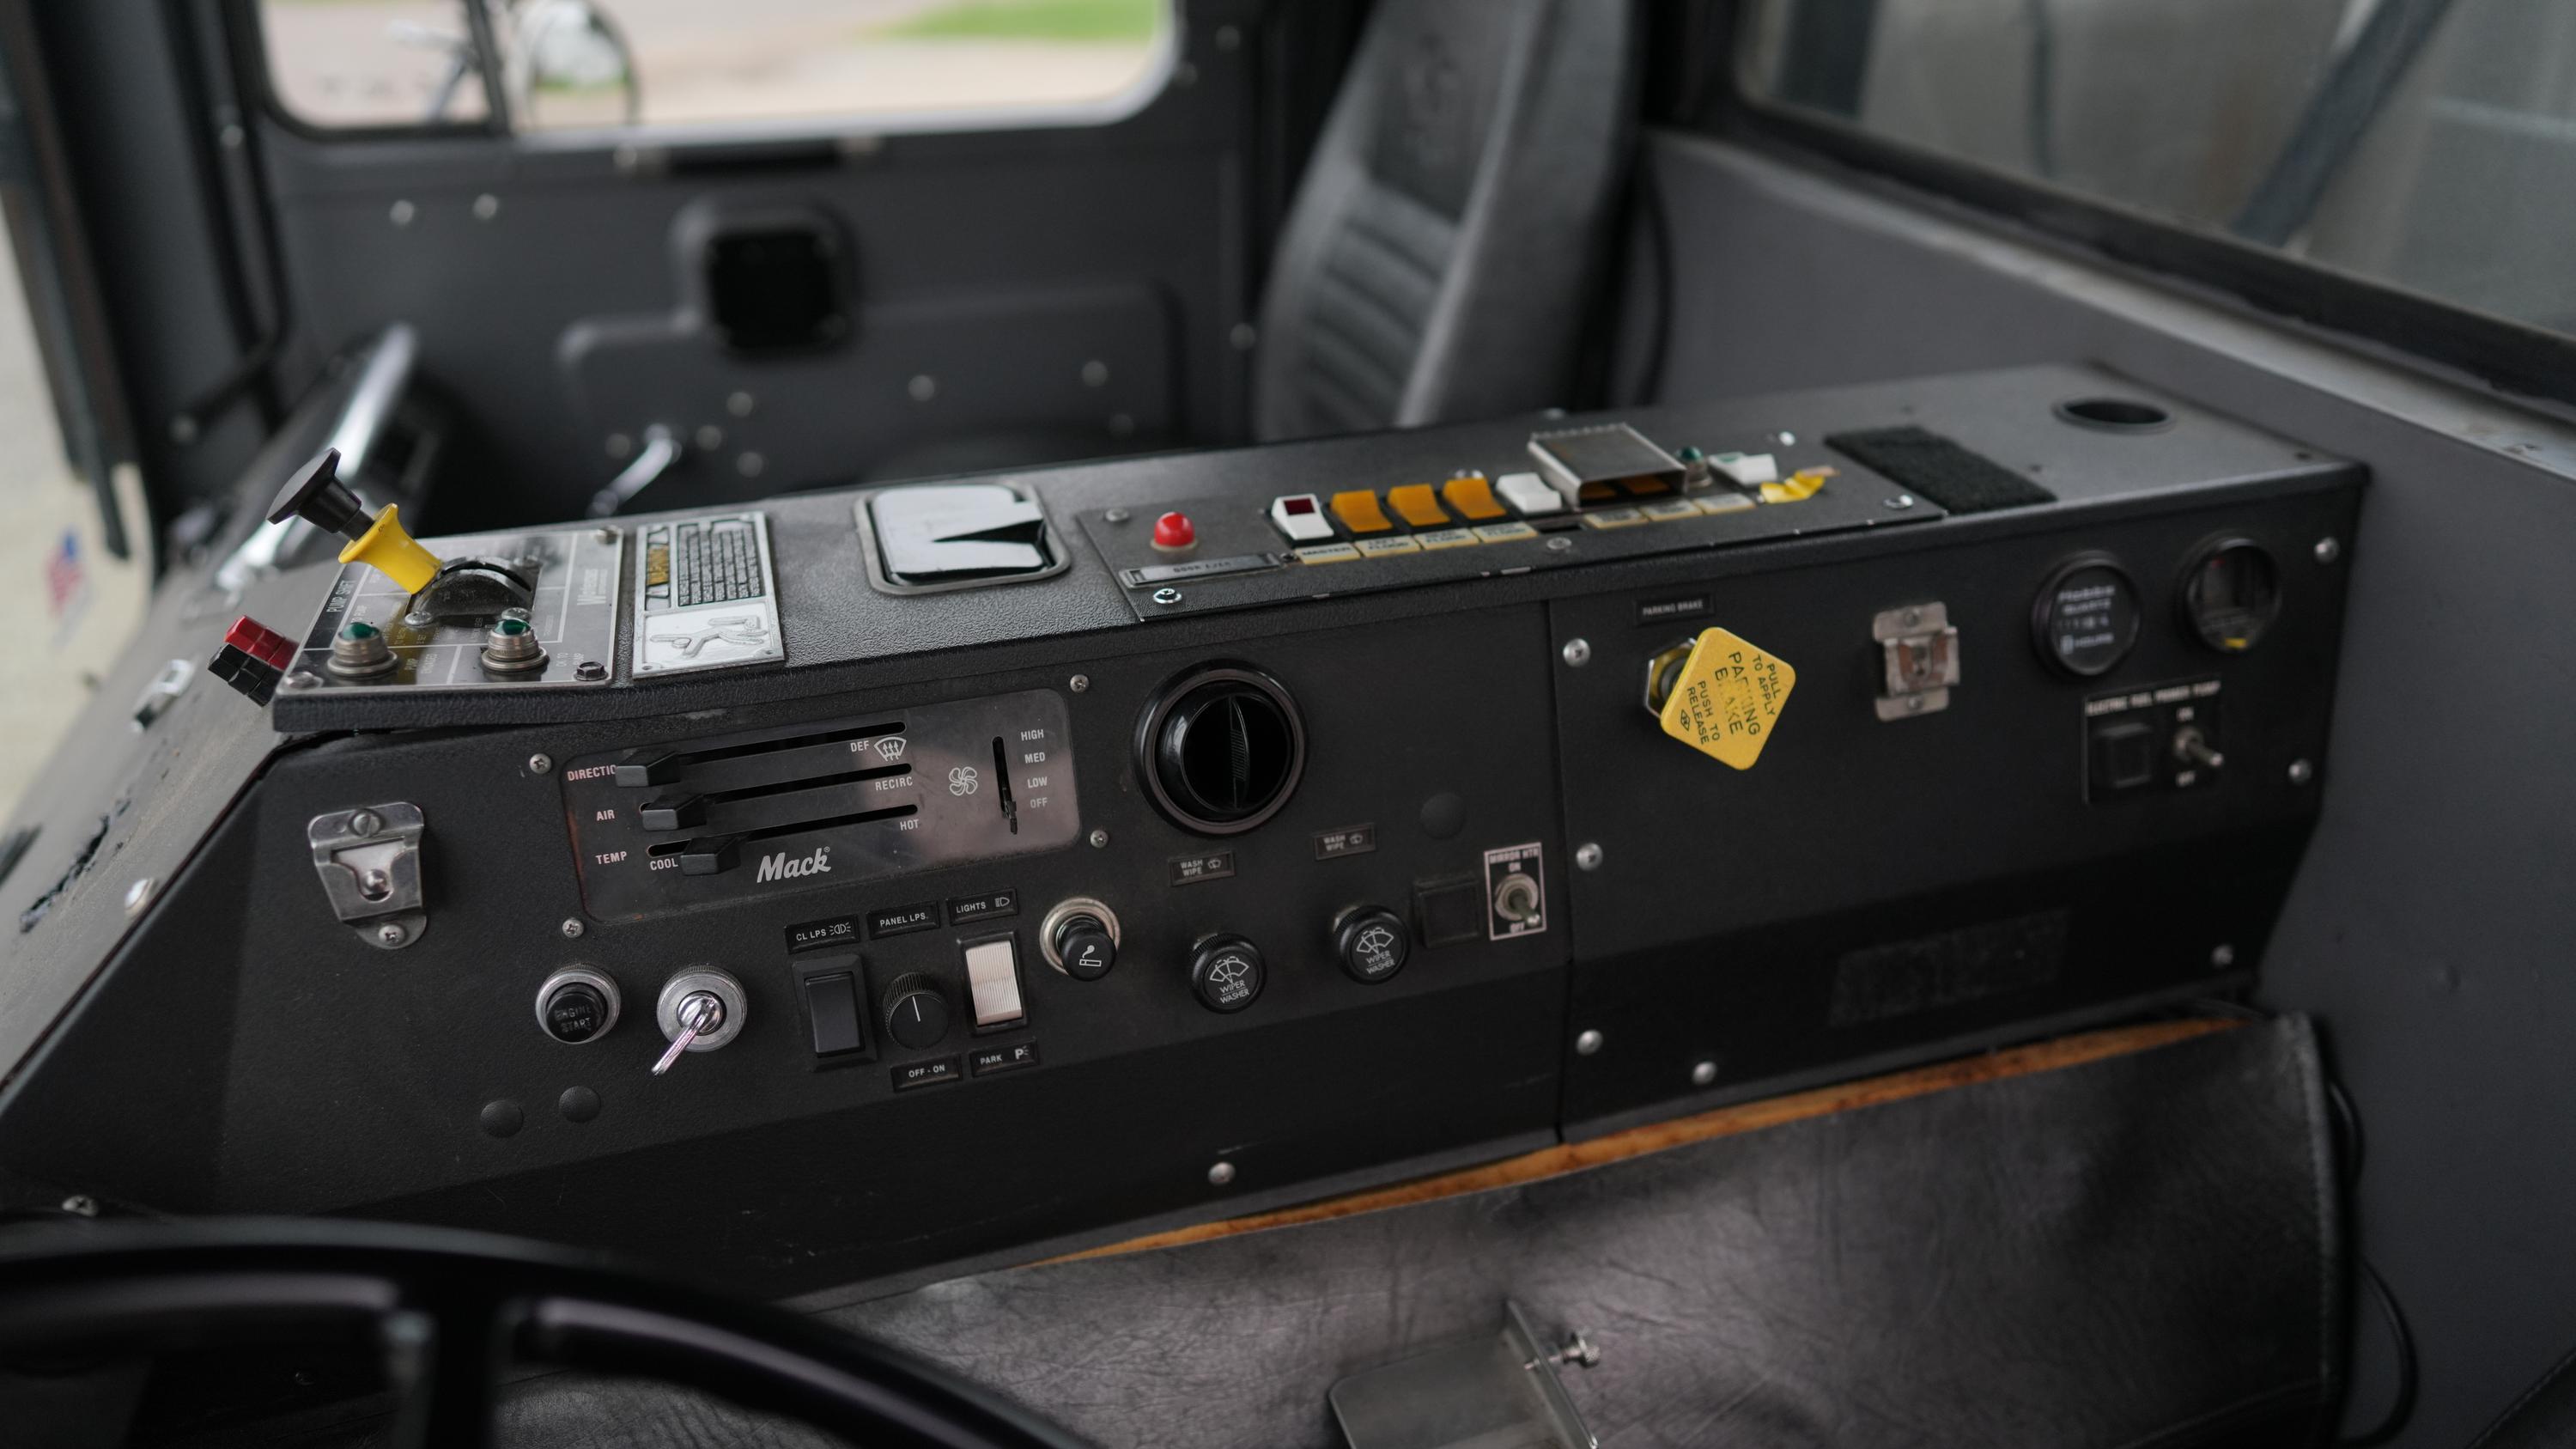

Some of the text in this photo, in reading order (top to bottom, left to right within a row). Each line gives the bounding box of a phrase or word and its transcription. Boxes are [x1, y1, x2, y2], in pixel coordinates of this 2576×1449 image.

[1302, 545, 1352, 556] MASTER
[326, 581, 358, 612] PUMP SHIFT
[1643, 600, 1703, 616] PARKING BRAKE
[1753, 654, 1776, 716] TO APPLY
[1765, 662, 1782, 699] PULL
[1728, 650, 1760, 736] PAING
[1714, 667, 1744, 735] BAKE
[1686, 686, 1710, 746] RELEASE
[1697, 679, 1721, 741] PUSH TO
[1021, 729, 1045, 741] HIGH
[850, 740, 870, 752] DEF
[1024, 752, 1046, 764] MED
[567, 764, 617, 782] DIRECTIO
[875, 776, 914, 791] RECIRC
[1027, 776, 1048, 788] LOW
[1030, 797, 1048, 808] OFF
[596, 809, 616, 821] AIR
[900, 819, 920, 831] HOT
[1323, 835, 1346, 845] WASH
[1326, 842, 1345, 851] WIPE
[596, 850, 628, 865] TEMP
[1490, 848, 1539, 864] MIRROR HTR
[649, 857, 678, 871] COOL
[1180, 860, 1202, 870] WASH
[1509, 861, 1521, 872] ON
[1182, 867, 1202, 877] WIPE
[956, 901, 987, 914] LIGHTS
[879, 911, 928, 928] PANEL LPS.
[796, 928, 827, 941] CL LPS
[1510, 922, 1525, 935] OFF
[1365, 950, 1391, 965] WIPER
[1367, 958, 1395, 975] WASHER
[1219, 979, 1246, 994] WIPER
[1219, 989, 1250, 1004] WASHER
[561, 1017, 592, 1032] START
[980, 1054, 1002, 1065] PARK
[908, 1067, 926, 1078] OFF
[933, 1064, 946, 1075] ON
